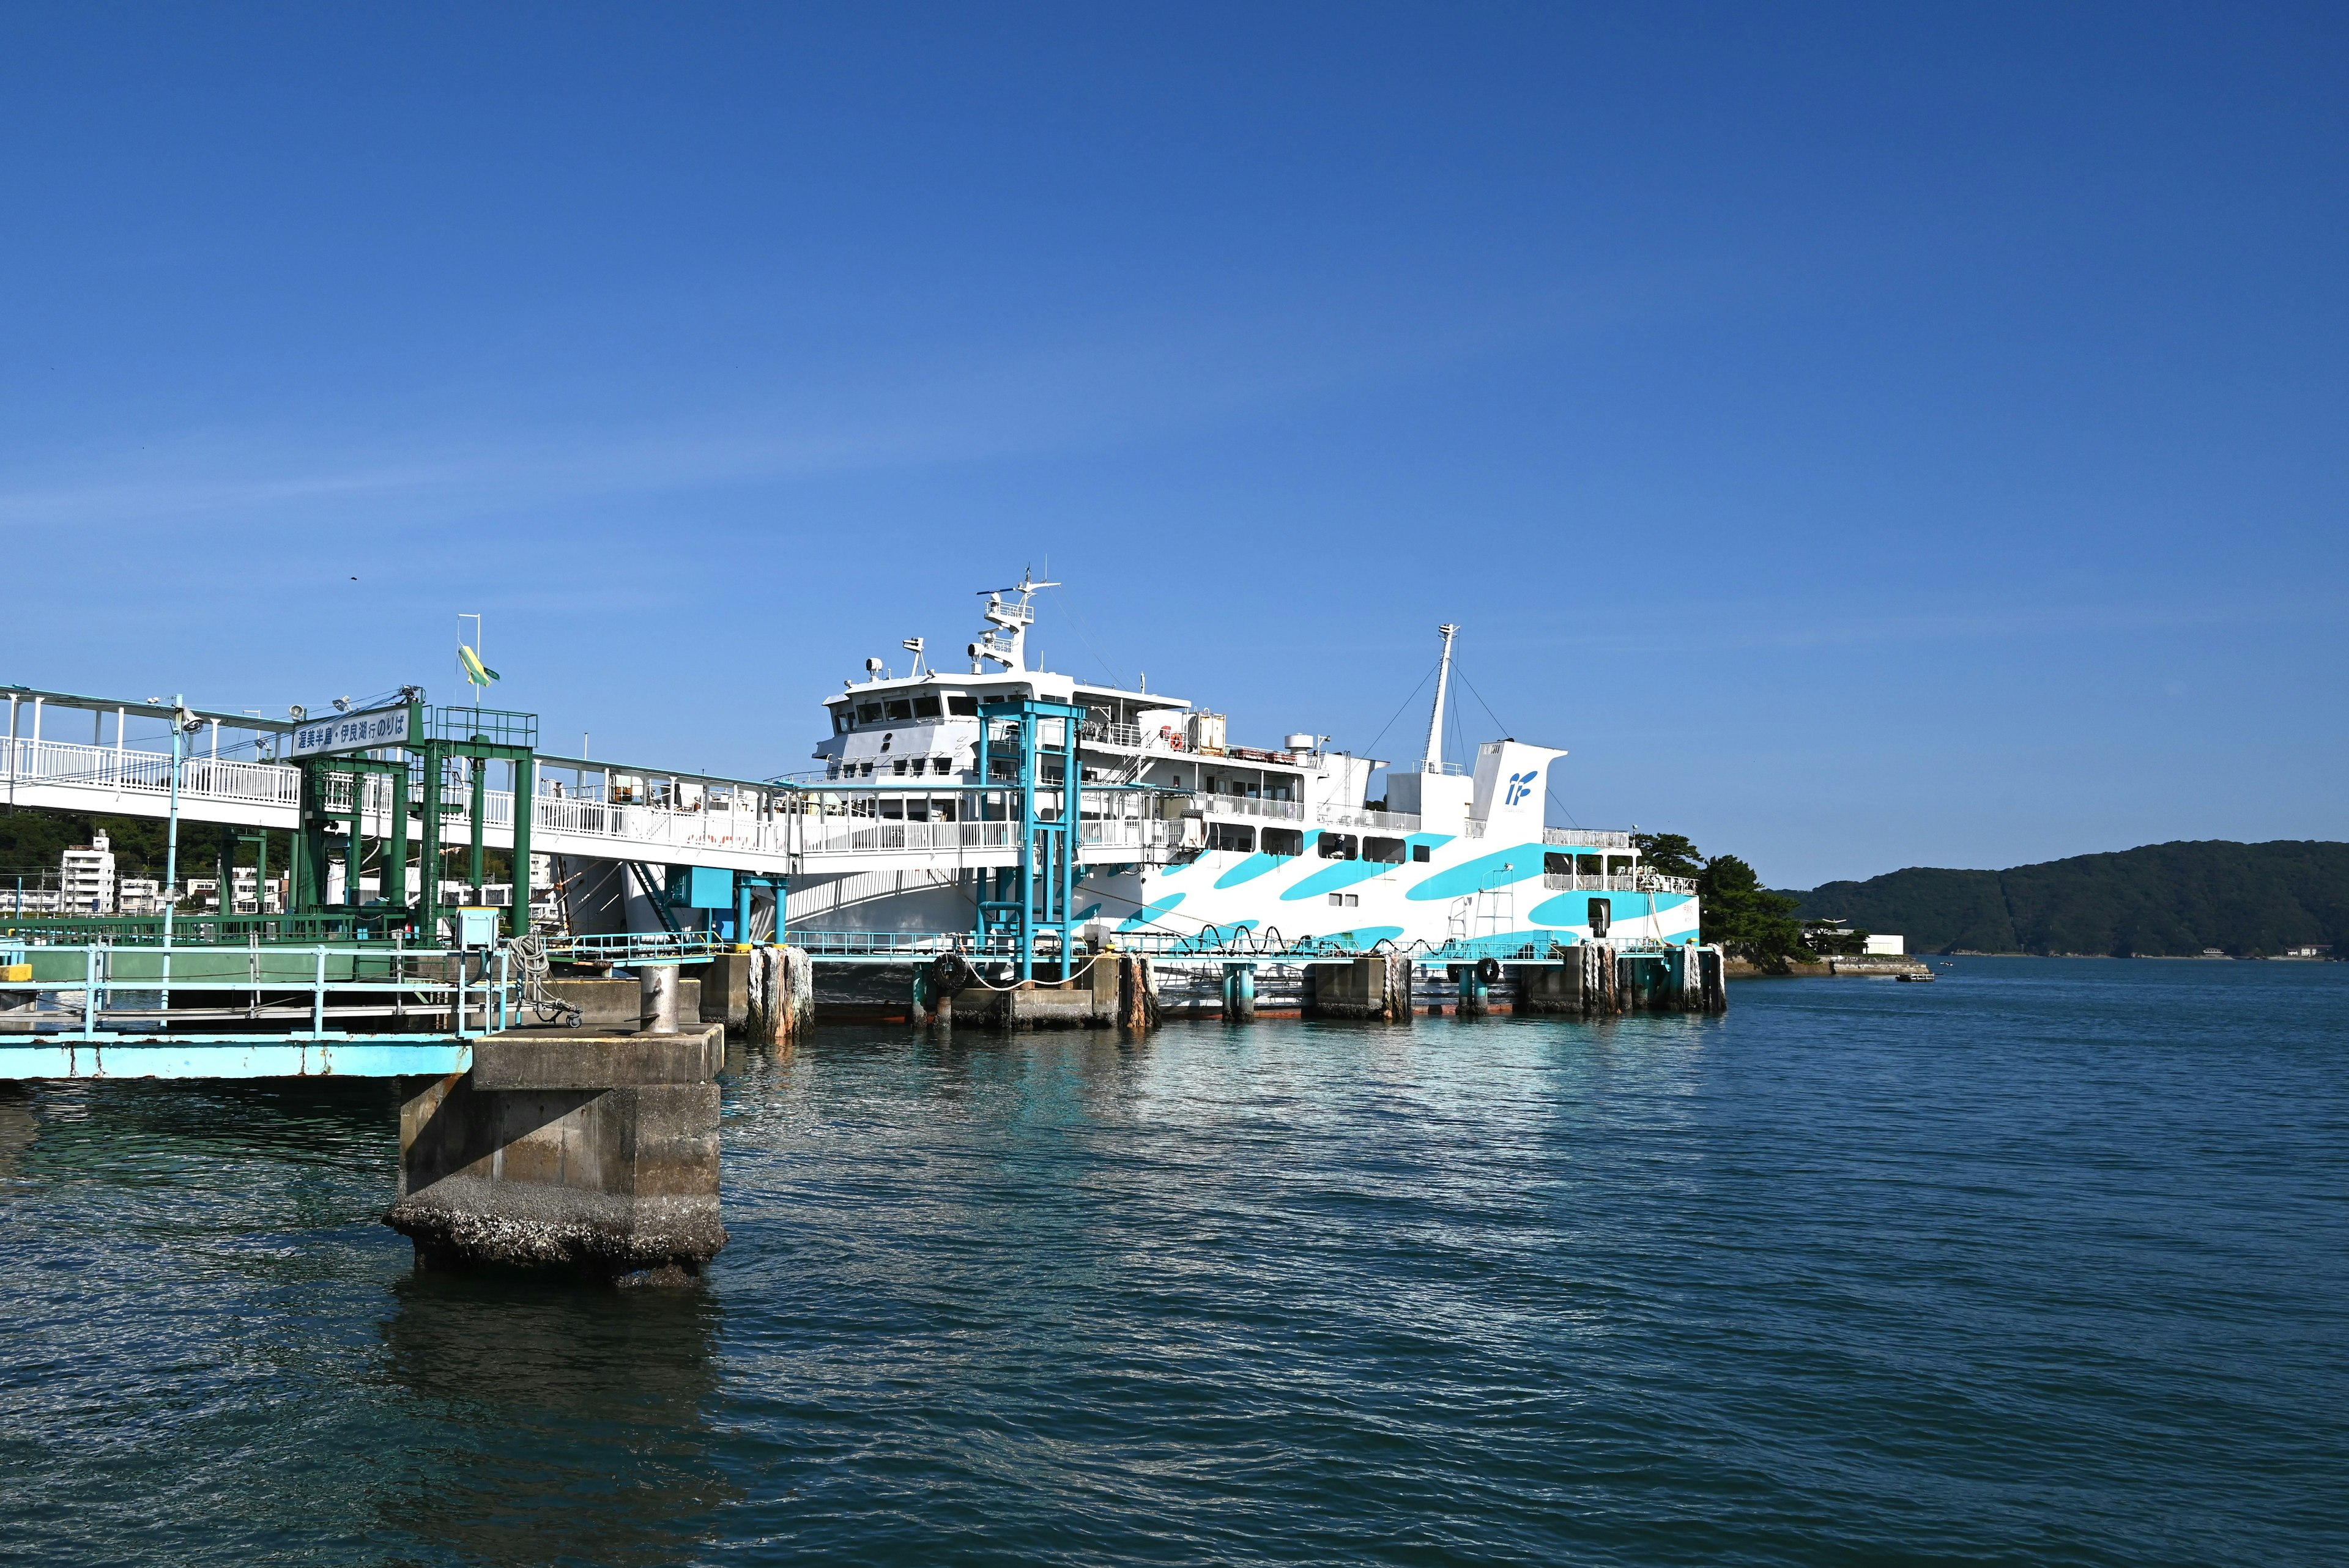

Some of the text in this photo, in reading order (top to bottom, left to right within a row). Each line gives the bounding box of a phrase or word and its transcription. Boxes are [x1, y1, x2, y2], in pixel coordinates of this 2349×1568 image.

[299, 715, 404, 749] 渥美半島・伊良湖行のりば
